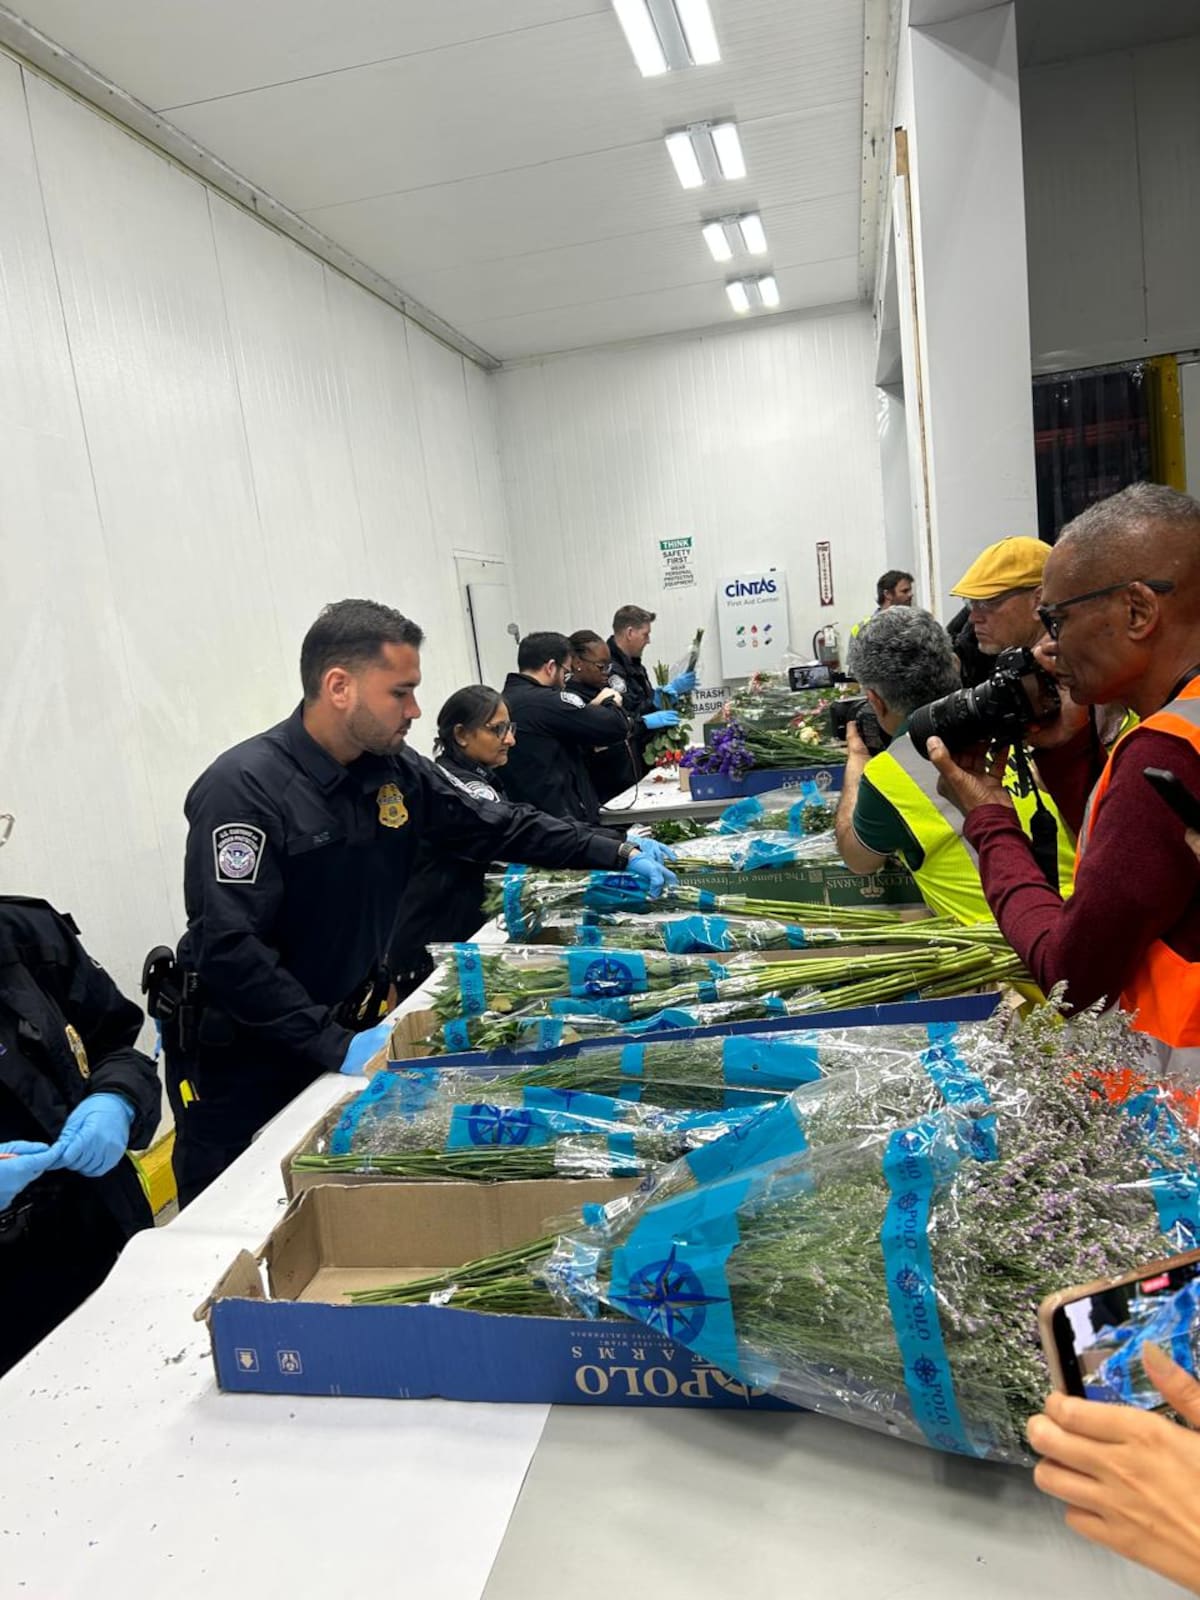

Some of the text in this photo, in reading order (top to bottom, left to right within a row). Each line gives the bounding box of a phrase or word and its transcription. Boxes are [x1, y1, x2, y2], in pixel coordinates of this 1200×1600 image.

[664, 539, 689, 549] THINK
[663, 549, 690, 558] SAFETY
[667, 556, 687, 566] FIRST
[695, 689, 725, 699] TRASH
[693, 701, 722, 712] BASUR
[737, 875, 748, 885] of
[752, 872, 782, 882] Home
[784, 872, 805, 881] The
[826, 878, 864, 888] FARMS
